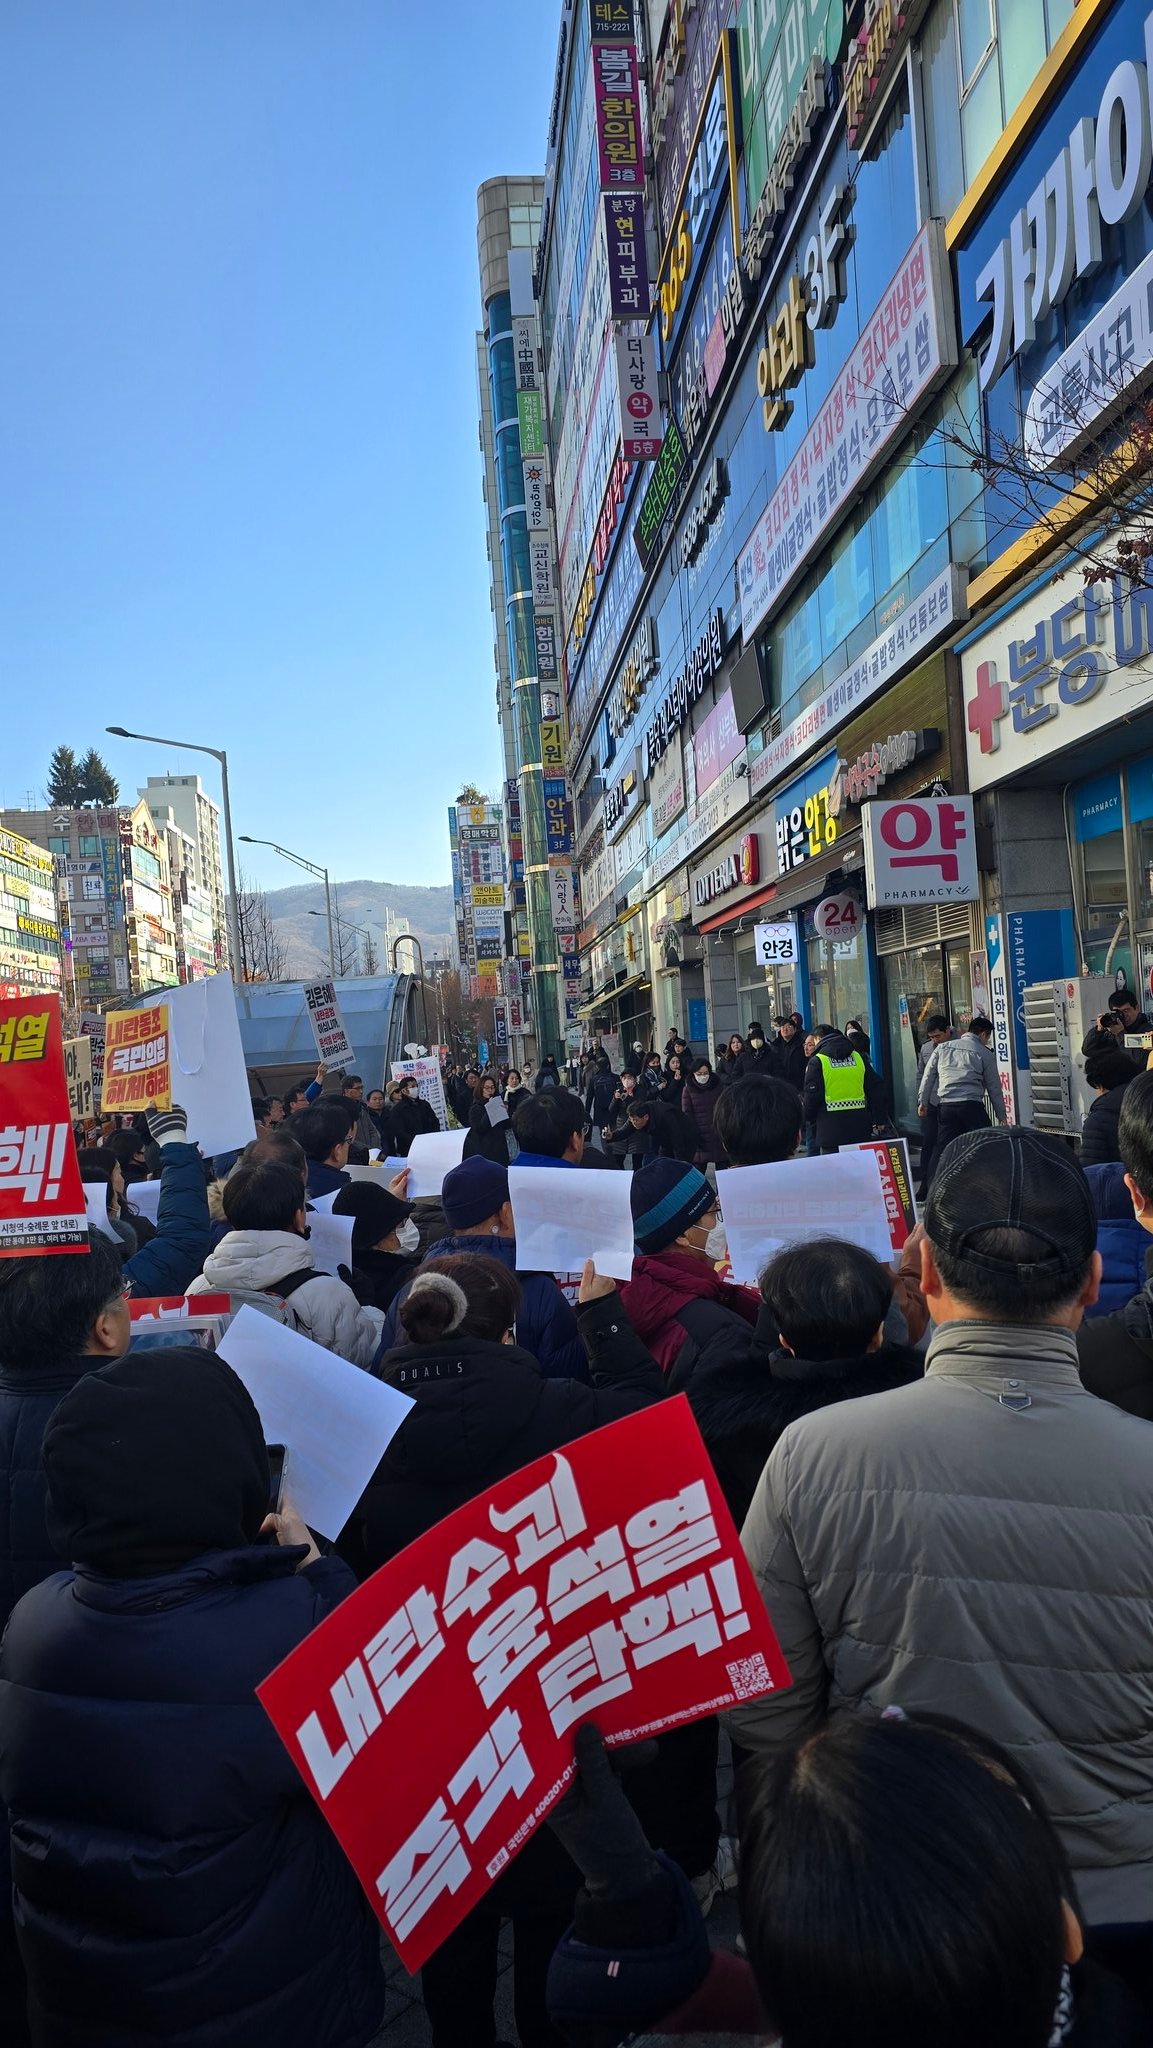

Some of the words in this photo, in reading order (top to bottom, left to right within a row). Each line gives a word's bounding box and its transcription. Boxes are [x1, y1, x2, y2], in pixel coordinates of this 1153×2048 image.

[595, 4, 629, 21] 테스
[595, 22, 630, 32] 715-2221
[609, 168, 637, 182] 3층
[611, 199, 636, 213] 분당
[614, 216, 641, 308] 현피부과
[804, 186, 843, 330] 3F
[518, 348, 535, 388] 中國語
[1040, 305, 1135, 448] 교통사고
[628, 338, 651, 437] 더사랑약국
[633, 441, 655, 454] 5층
[536, 626, 554, 669] 한의원
[543, 724, 562, 763] 기원
[547, 797, 567, 836] 안과
[1082, 796, 1118, 818] PHARMACY
[554, 841, 565, 850] 3F
[880, 803, 967, 882] 약
[85, 880, 101, 891] 진료
[694, 855, 739, 907] LOTTERIA
[884, 886, 953, 900] PHARMACY
[823, 901, 858, 927] 24
[825, 924, 857, 937] open
[762, 938, 794, 961] 안경
[993, 976, 1009, 1063] 대학병원
[1068, 1001, 1075, 1009] LG
[107, 1008, 161, 1046] 내란동조
[497, 1021, 507, 1039] PC
[112, 1036, 167, 1073] 국민의힘
[106, 1064, 169, 1105] 해체하라!
[1, 1220, 50, 1234] 시청역-숭례문
[51, 1220, 59, 1230] 앞
[60, 1219, 79, 1230] 대로)
[26, 1235, 37, 1244] 1만
[47, 1234, 59, 1243] 여러
[60, 1234, 67, 1242] 번
[67, 1233, 82, 1242] 가능)
[466, 1478, 722, 1711] 윤석열
[296, 1451, 588, 1801] 내란수괴
[375, 1705, 536, 1944] 즉각
[537, 1557, 752, 1740] 탄핵!
[507, 1816, 537, 1851] 국민은행
